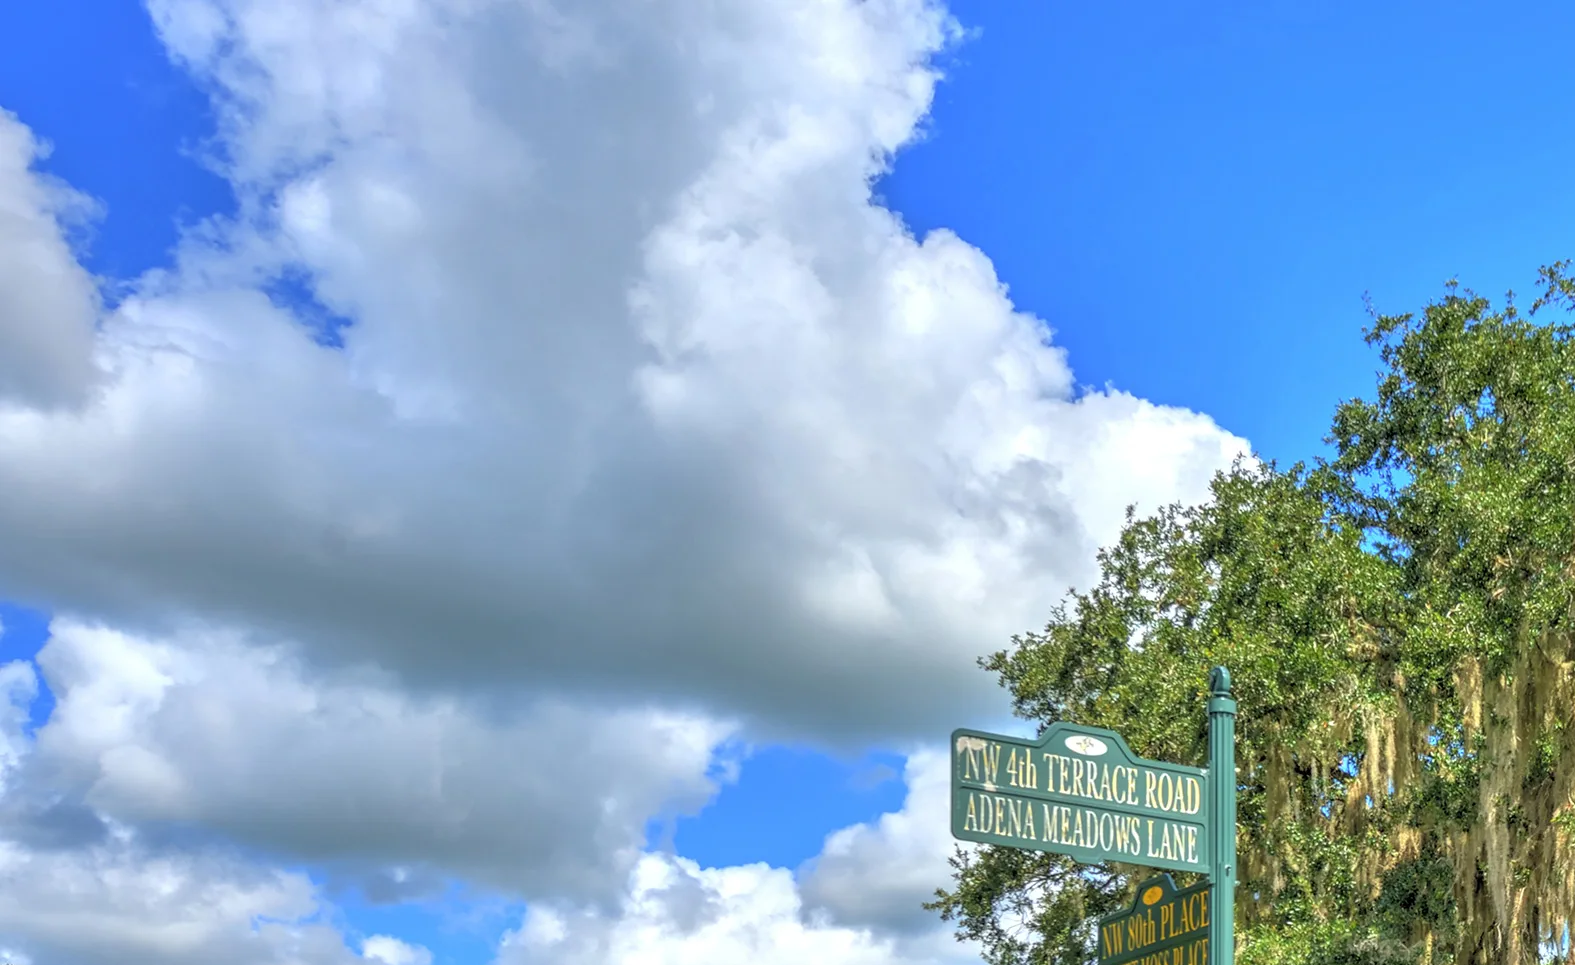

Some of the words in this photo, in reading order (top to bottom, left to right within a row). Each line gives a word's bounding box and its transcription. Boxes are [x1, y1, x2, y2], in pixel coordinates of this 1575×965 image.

[964, 741, 1001, 784] NW
[1006, 748, 1037, 789] 4th
[1043, 753, 1138, 805] TERRACE
[1145, 770, 1200, 815] ROAD
[964, 792, 1036, 840] ADENA
[1042, 803, 1140, 856] MEADOWS
[1146, 820, 1199, 864] LANE
[1102, 920, 1125, 960] NW
[1127, 908, 1156, 951] 80th
[1160, 890, 1209, 940] PLACE
